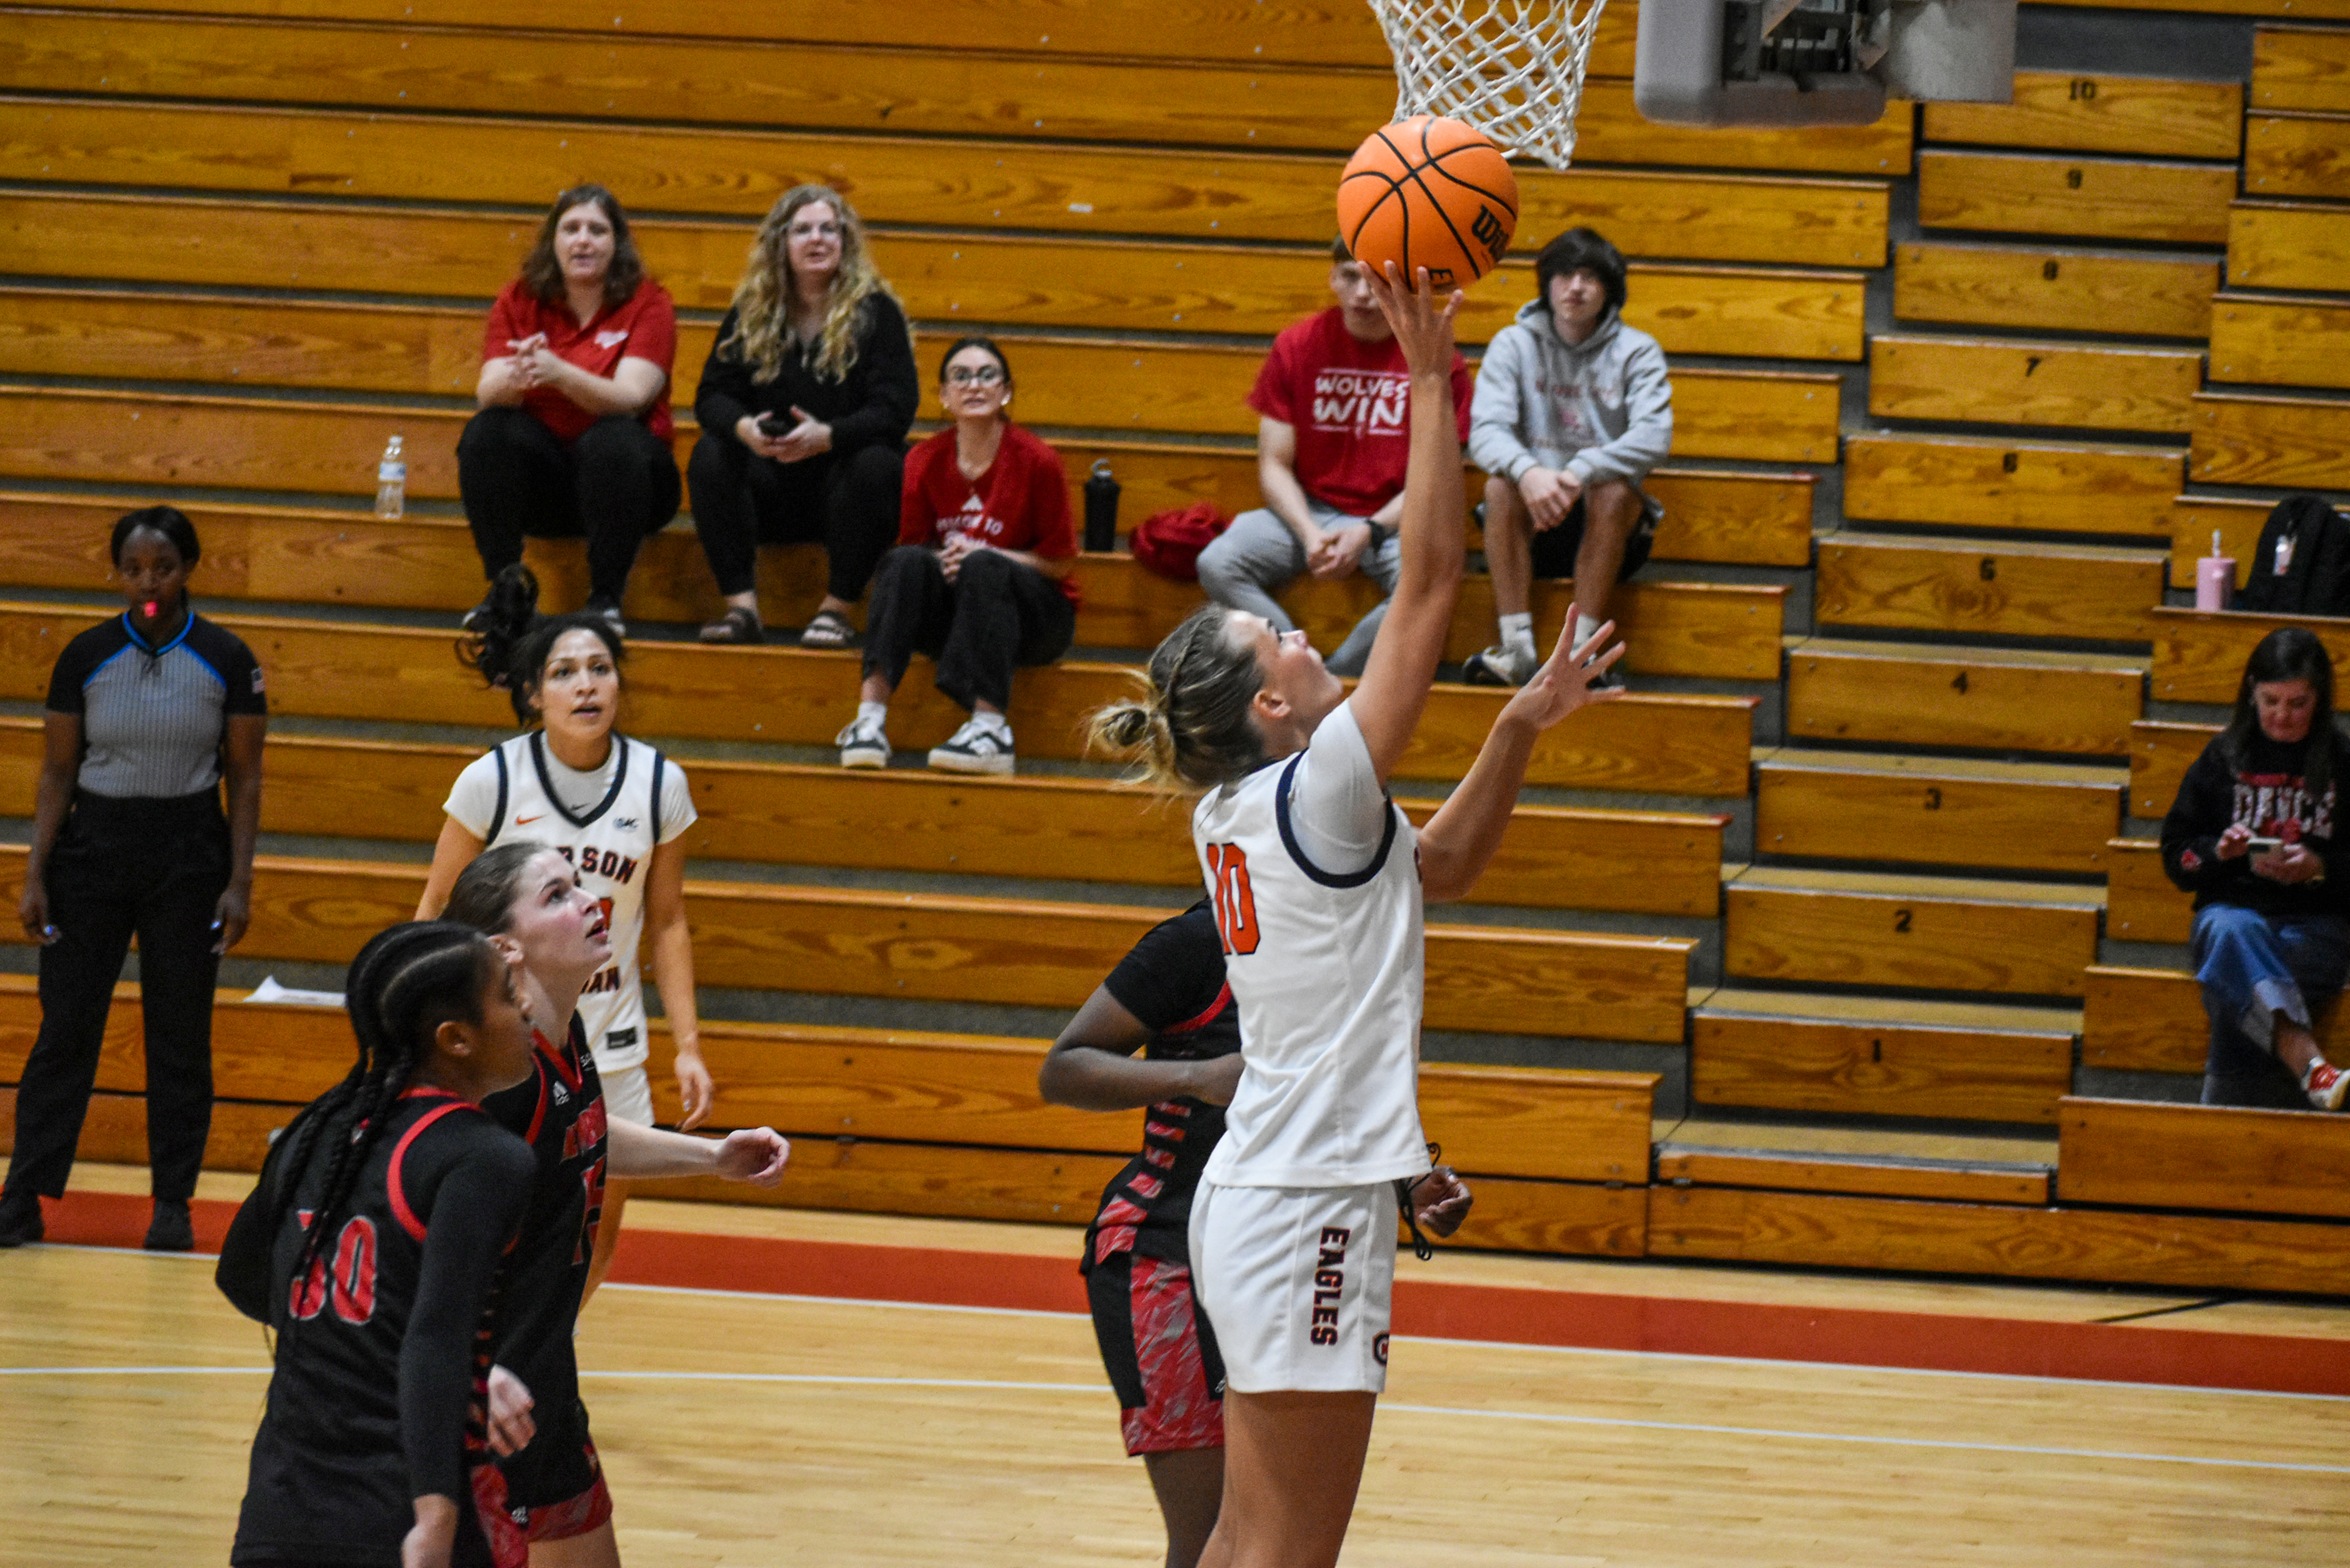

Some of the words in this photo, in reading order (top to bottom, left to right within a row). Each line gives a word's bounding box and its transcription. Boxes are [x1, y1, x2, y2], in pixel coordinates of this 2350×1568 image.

[2069, 81, 2096, 101] 10
[2067, 169, 2084, 189] 9
[2026, 356, 2042, 377] 7
[1315, 376, 1410, 400] WOLVES
[1313, 397, 1406, 428] WIN
[1950, 671, 1970, 695] 4
[1925, 787, 1943, 811] 3
[556, 845, 638, 887] RSON
[1206, 842, 1262, 956] 10
[1893, 909, 1914, 934] 2
[1870, 1039, 1884, 1064] 1
[1310, 1226, 1351, 1346] EAGLES
